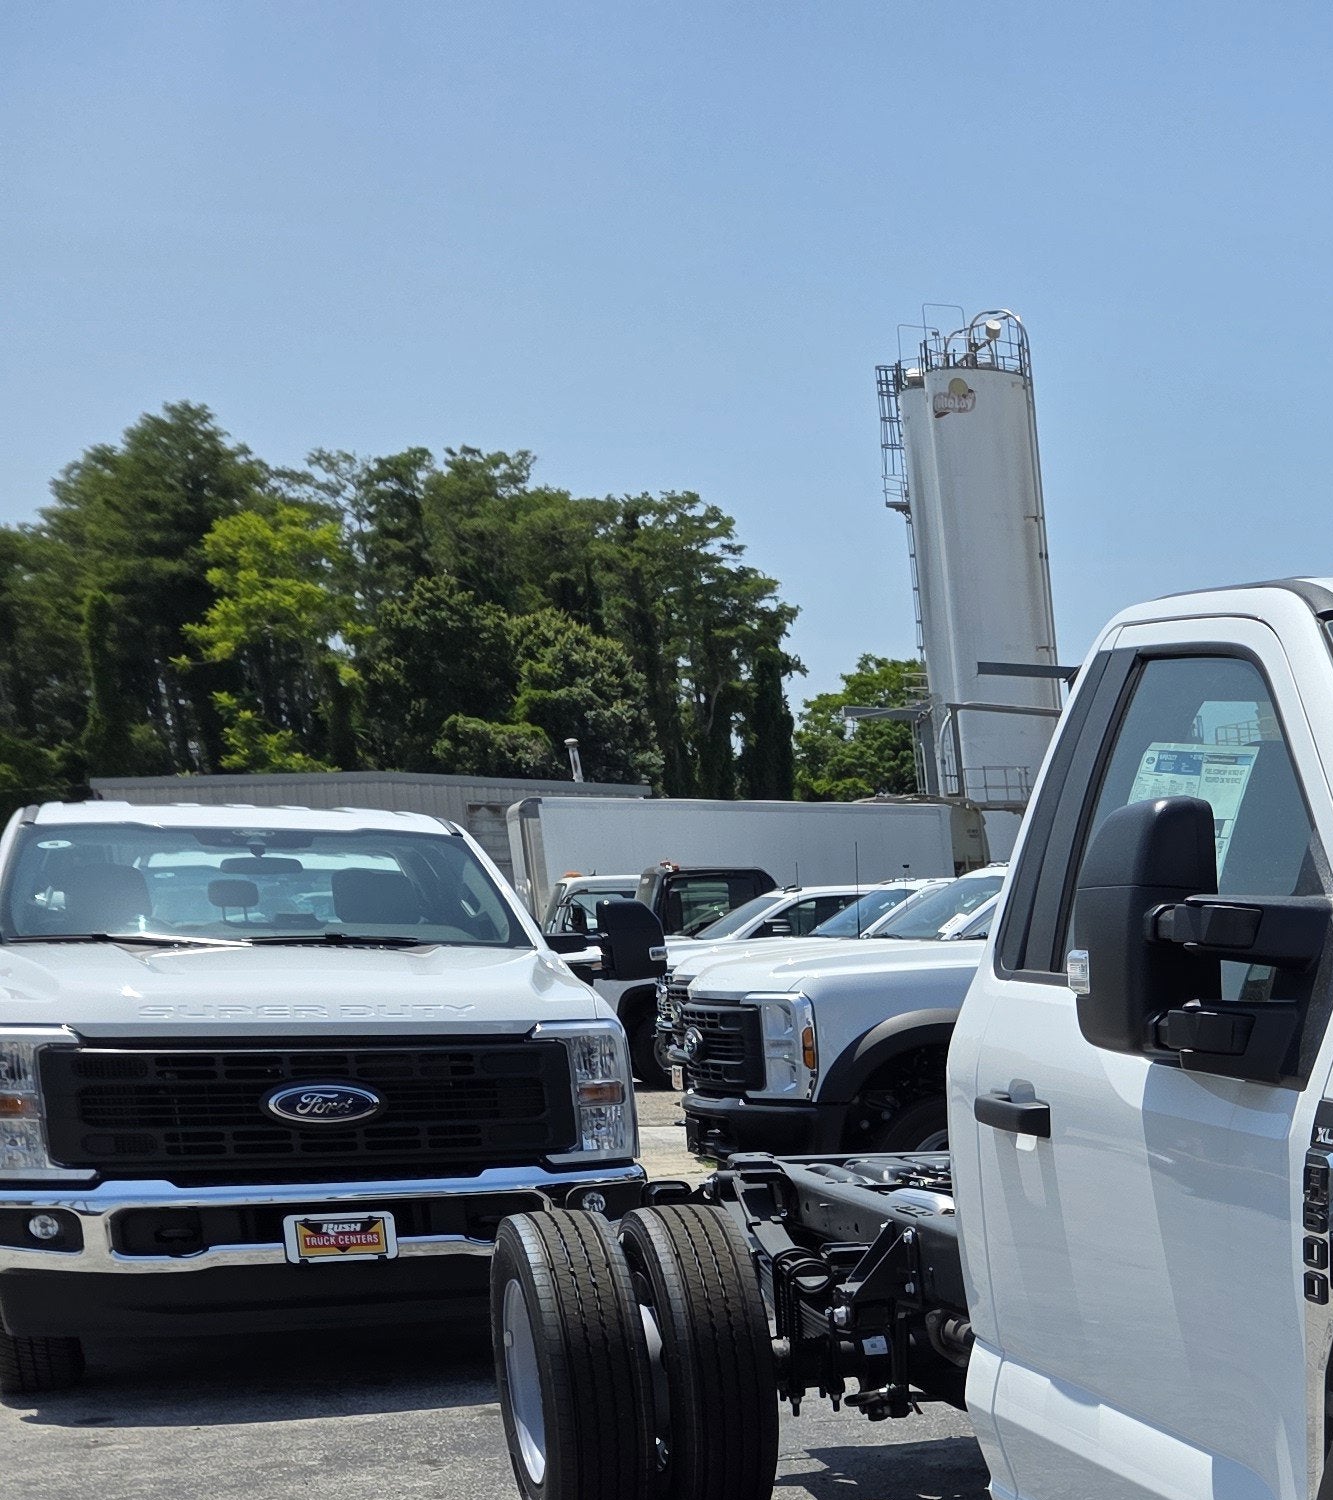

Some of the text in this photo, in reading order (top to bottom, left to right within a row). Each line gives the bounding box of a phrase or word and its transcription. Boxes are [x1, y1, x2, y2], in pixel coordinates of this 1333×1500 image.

[138, 1003, 477, 1019] SUPER DUTY
[296, 1093, 354, 1114] Ford
[1315, 1127, 1333, 1145] XL
[322, 1222, 361, 1234] RUSH
[306, 1234, 379, 1246] TRUCK CENTERS
